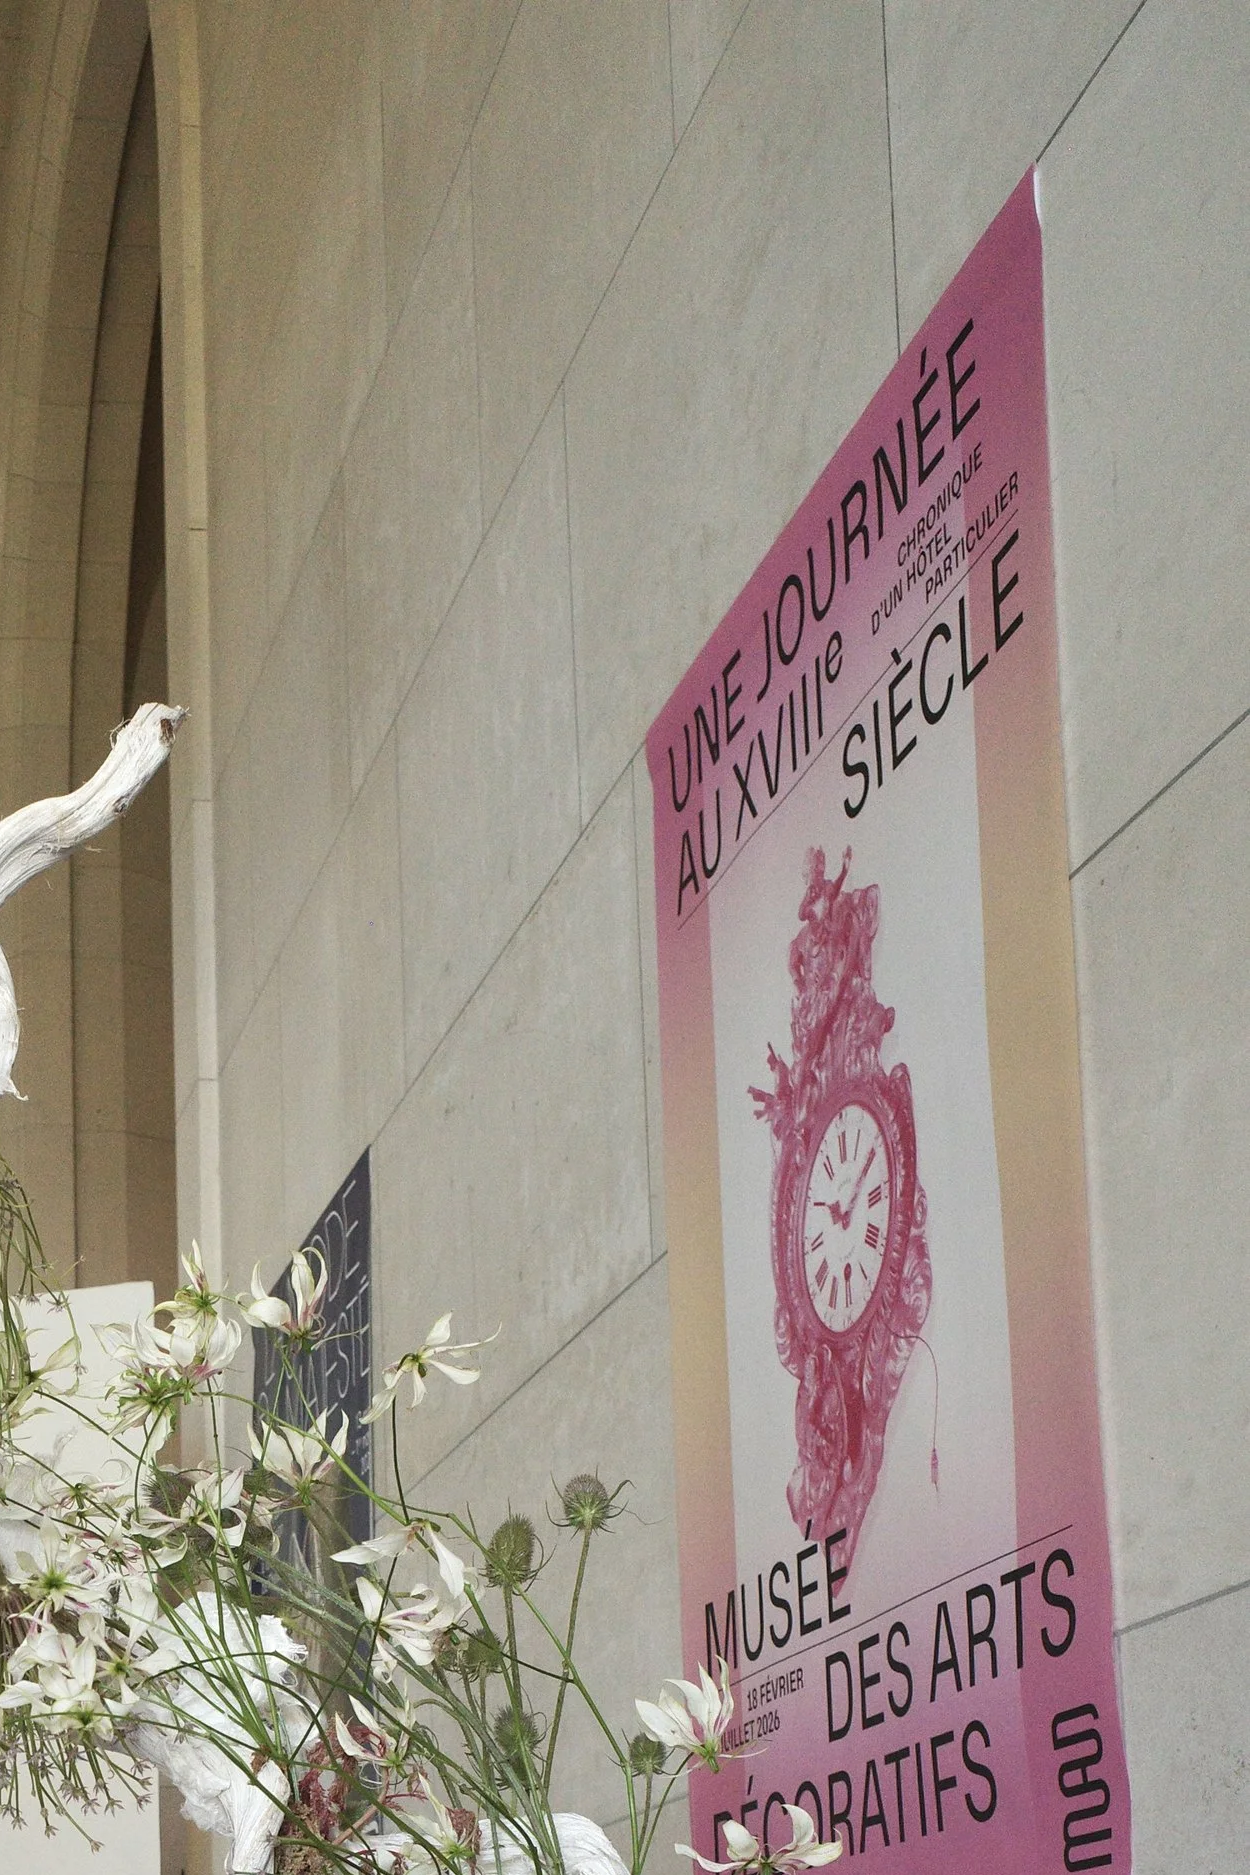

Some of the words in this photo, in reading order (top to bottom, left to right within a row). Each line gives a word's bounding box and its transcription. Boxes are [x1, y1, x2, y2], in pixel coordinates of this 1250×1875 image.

[667, 650, 746, 814] UNE
[756, 317, 983, 701] JOURNÉE
[898, 442, 983, 567] CHRONIQUE
[925, 471, 1019, 604] PARTICULIER
[871, 579, 903, 636] D'UN
[907, 523, 953, 592] HÔTEL
[844, 531, 1025, 819] SIÈCLE
[676, 807, 722, 916] AU
[736, 630, 844, 842] XVIIIe
[704, 1519, 851, 1678] MUSÉE
[825, 1621, 915, 1742] DES
[930, 1548, 1076, 1702] ARTS
[747, 1688, 758, 1711] 18
[760, 1667, 804, 1706] FÉVRIER
[757, 1710, 781, 1738] 2026
